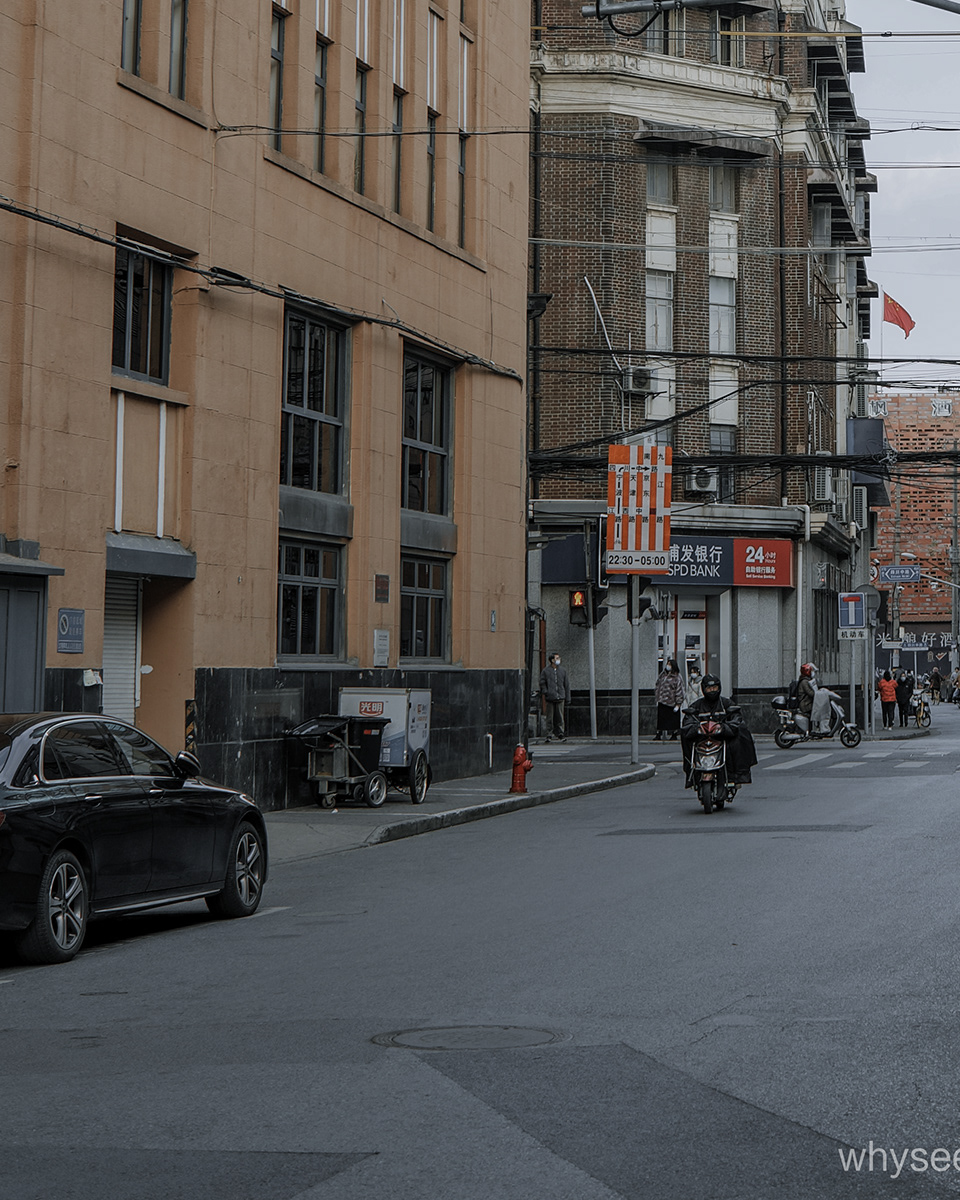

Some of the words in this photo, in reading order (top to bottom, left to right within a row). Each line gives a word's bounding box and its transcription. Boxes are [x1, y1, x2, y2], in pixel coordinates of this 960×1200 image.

[608, 555, 666, 566] 22:30-05:00
[745, 545, 765, 564] 24
[668, 563, 689, 576] SPD
[690, 564, 721, 577] BANK
[360, 702, 383, 712] 光明
